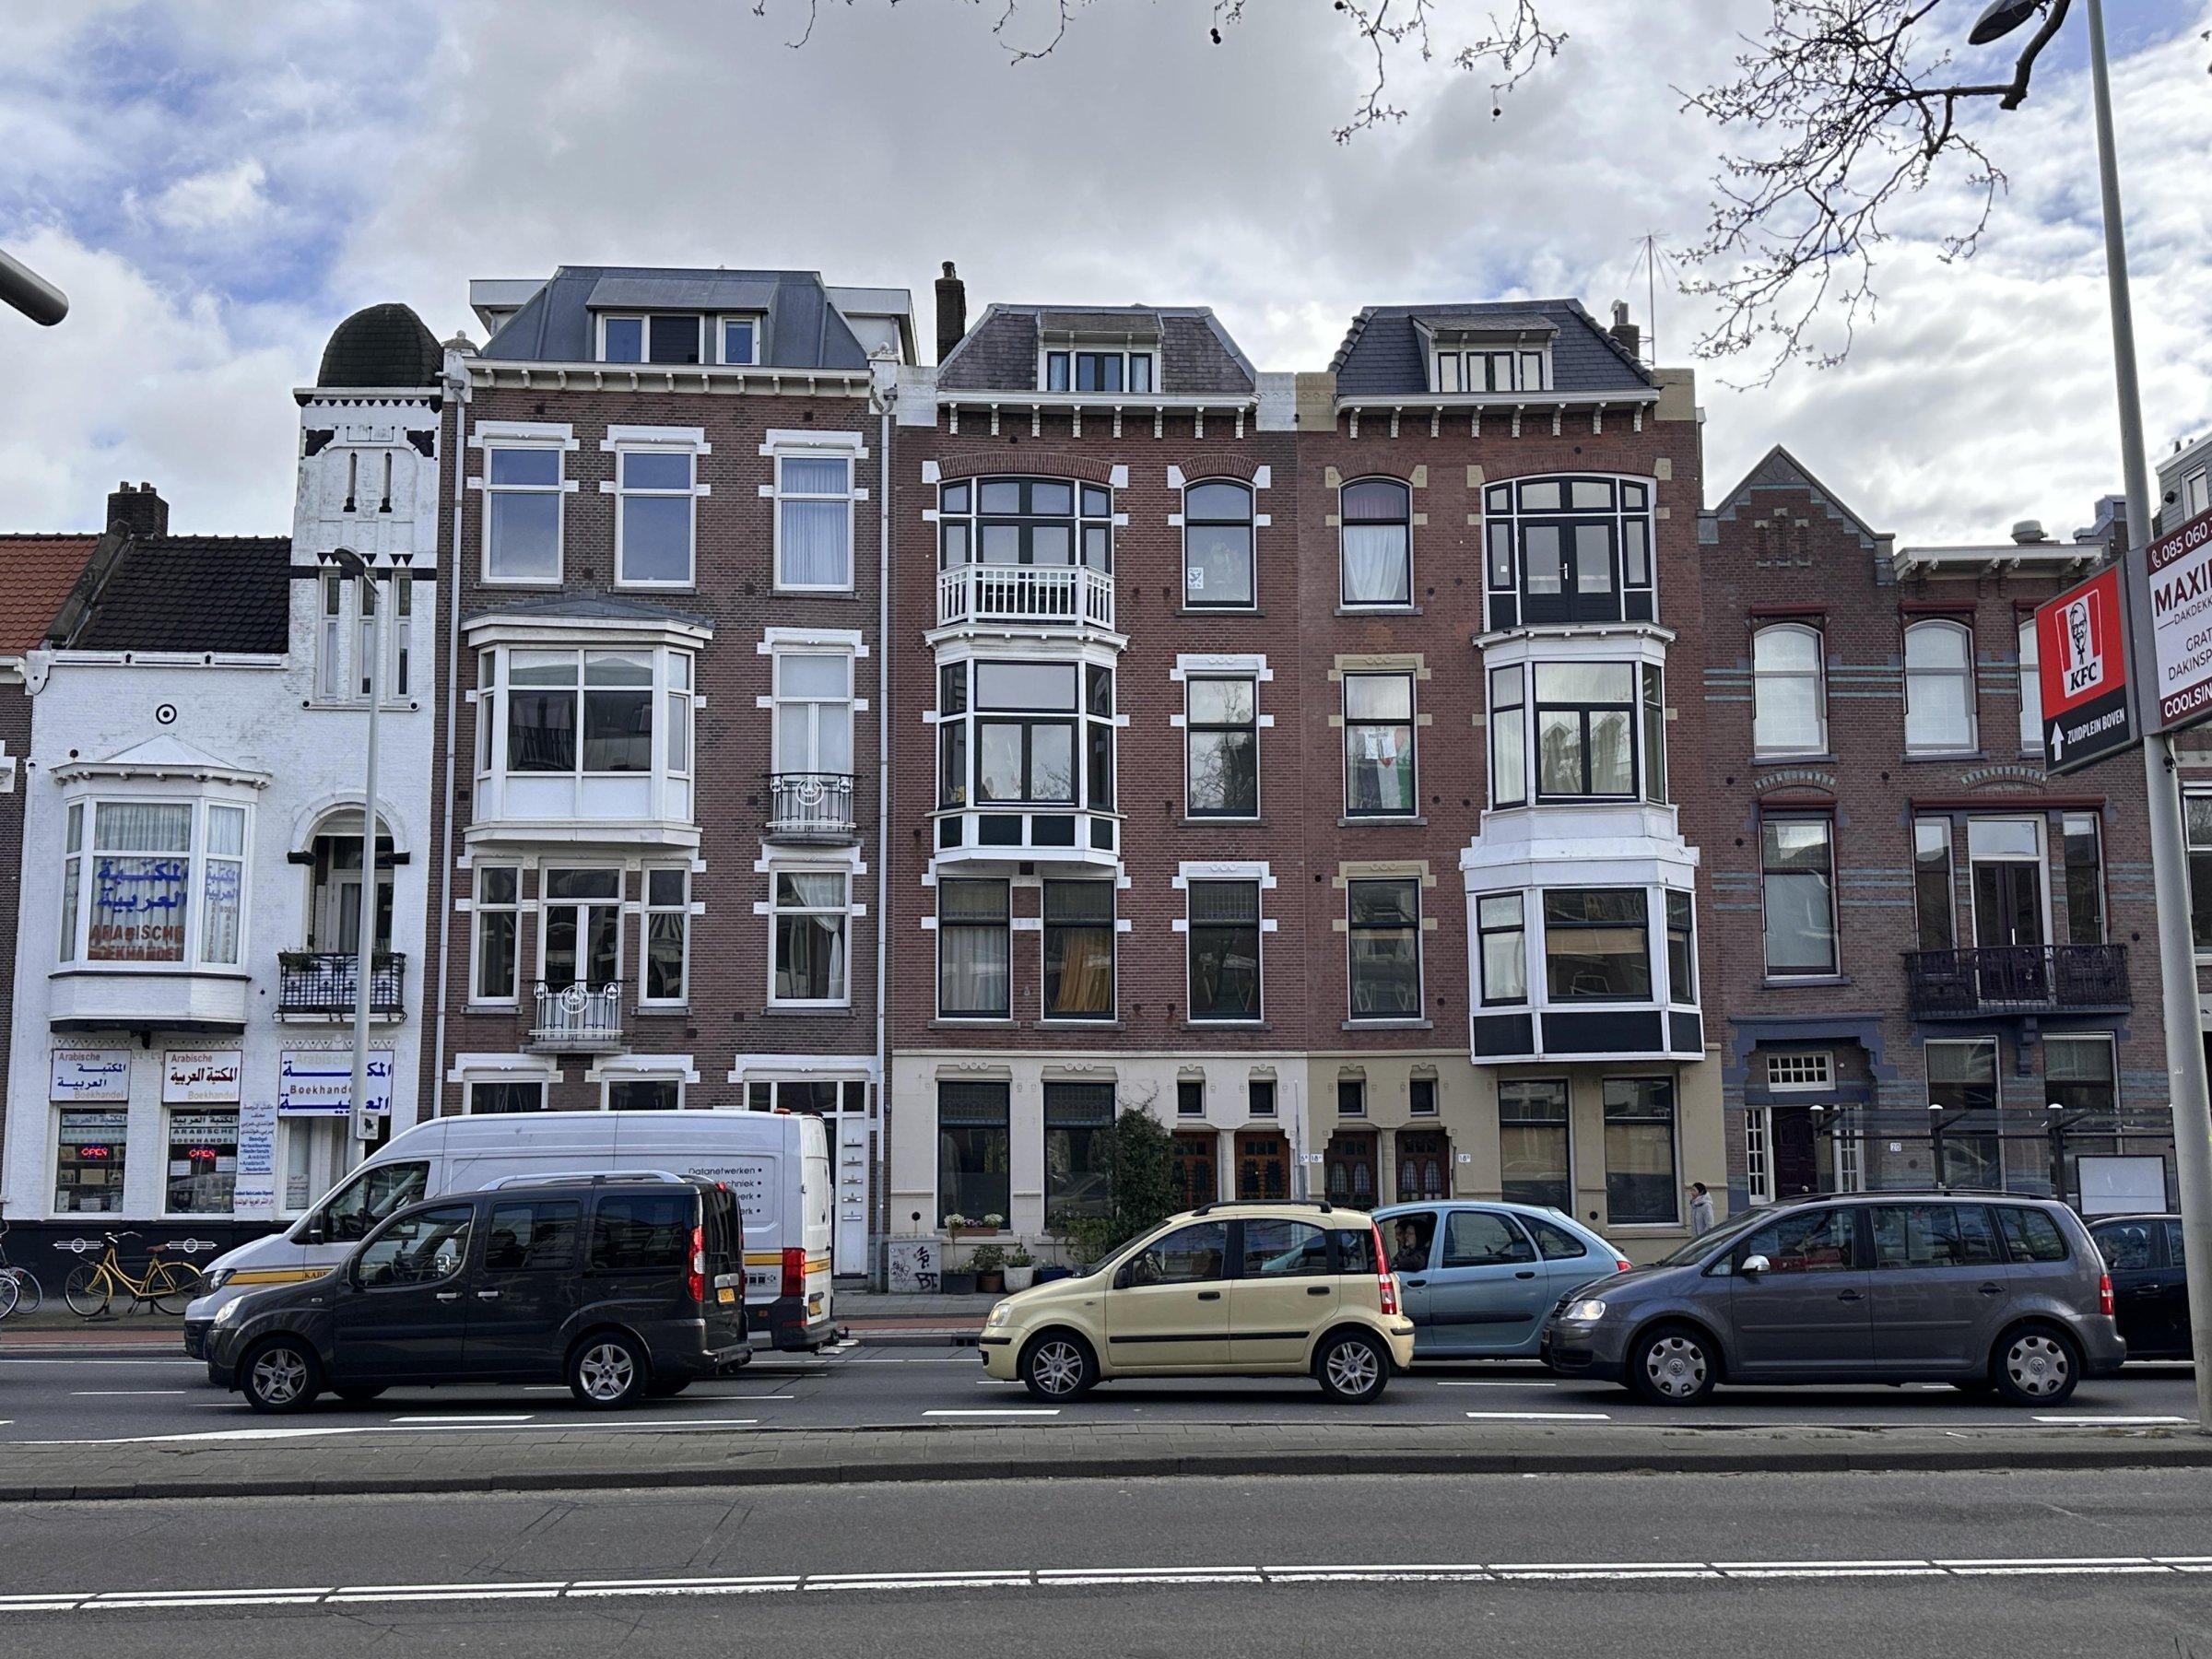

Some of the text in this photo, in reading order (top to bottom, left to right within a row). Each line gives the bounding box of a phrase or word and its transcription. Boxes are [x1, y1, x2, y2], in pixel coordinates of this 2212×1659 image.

[2161, 521, 2208, 562] 085 060
[2070, 662, 2098, 691] KFC
[2067, 707, 2125, 745] ZUIDPLEIN BOVEN
[58, 1052, 100, 1062] Arabische
[171, 1053, 213, 1063] Arabische
[76, 1063, 126, 1075] المكتبة
[171, 1066, 238, 1086] المكتبة العربية
[57, 1077, 107, 1090] العربية
[75, 1090, 124, 1100] Boekhandel
[188, 1090, 237, 1100] Boekhandel
[81, 1147, 109, 1157] OPEN
[189, 1147, 217, 1158] OPEN
[688, 1167, 756, 1175] Datanetwerken
